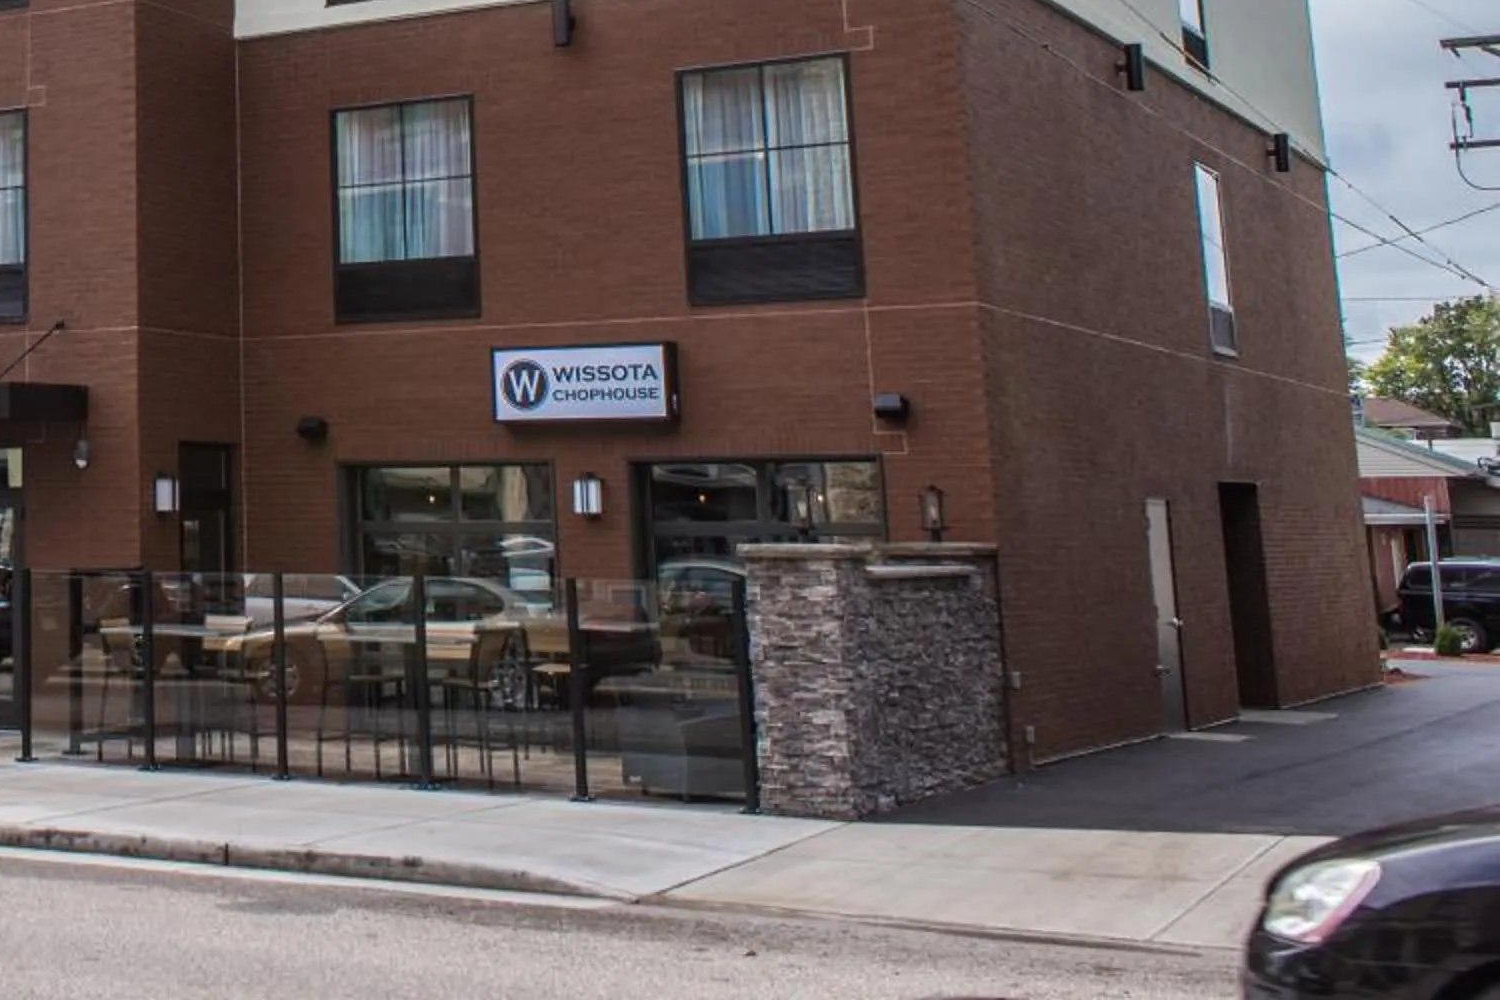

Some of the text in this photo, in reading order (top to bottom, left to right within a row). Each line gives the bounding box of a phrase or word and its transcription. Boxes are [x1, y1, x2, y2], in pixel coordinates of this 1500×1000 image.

[552, 363, 658, 383] WISSOTA
[508, 369, 540, 402] W
[552, 387, 660, 402] CHOPHOUSE
